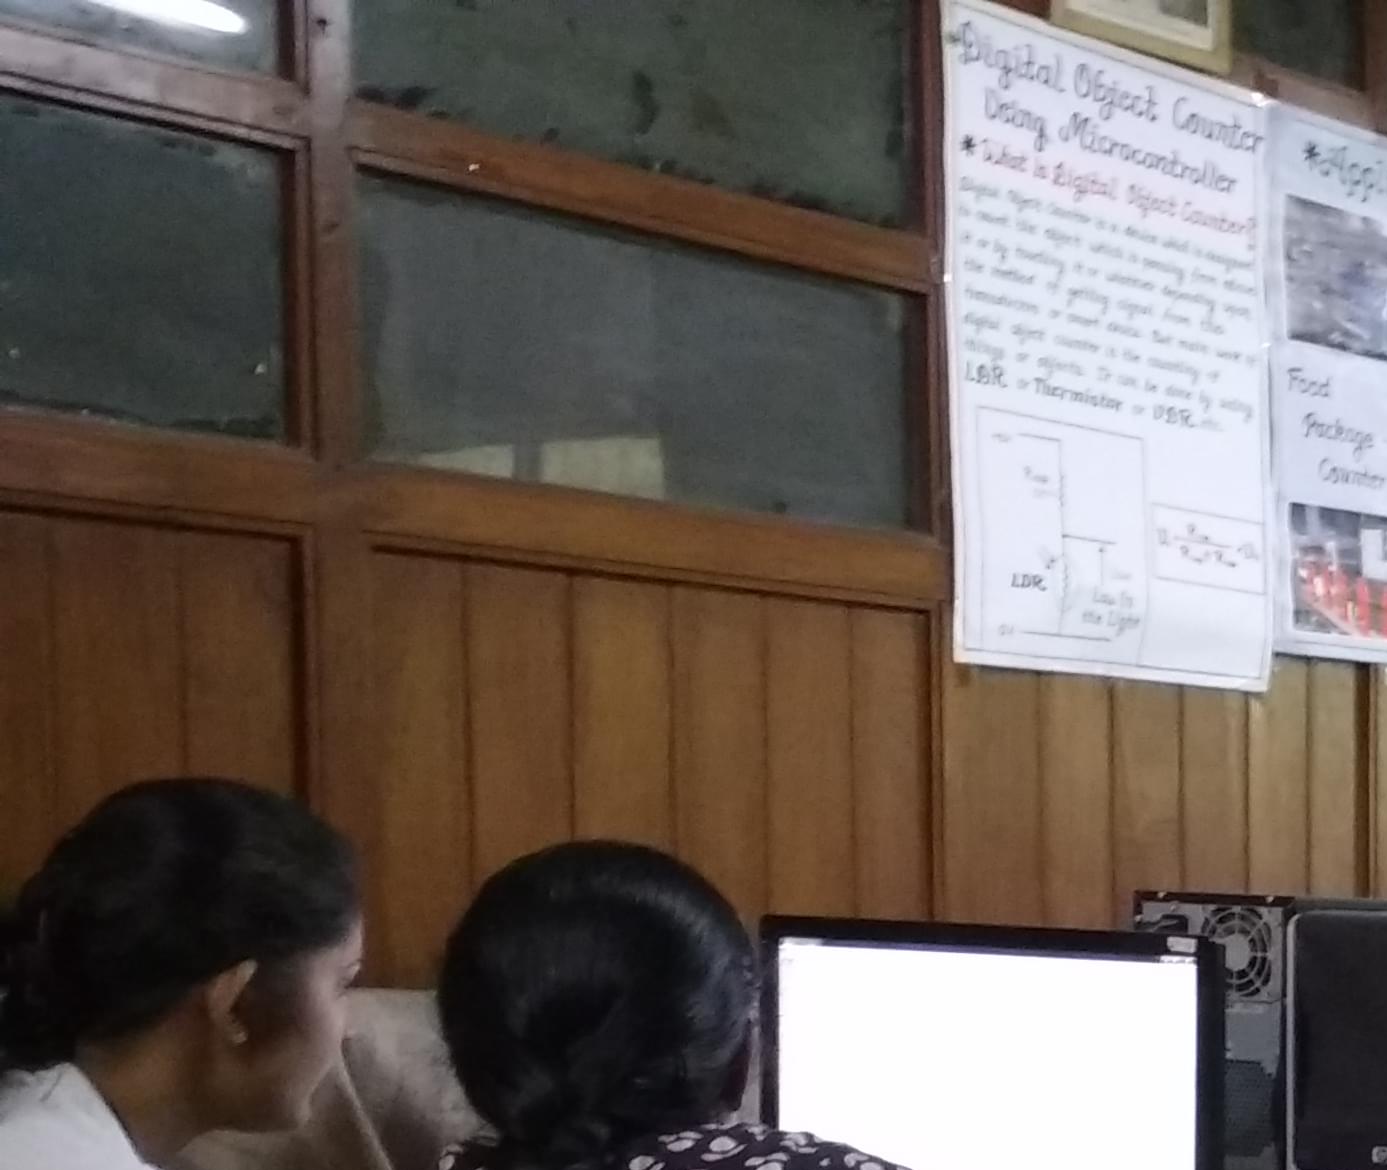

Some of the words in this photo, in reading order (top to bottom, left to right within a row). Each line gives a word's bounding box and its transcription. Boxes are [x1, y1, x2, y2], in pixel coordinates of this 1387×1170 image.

[958, 20, 1066, 92] Digital
[1073, 62, 1158, 122] Object
[1171, 97, 1265, 156] Counter
[1058, 110, 1238, 195] Microcontroller
